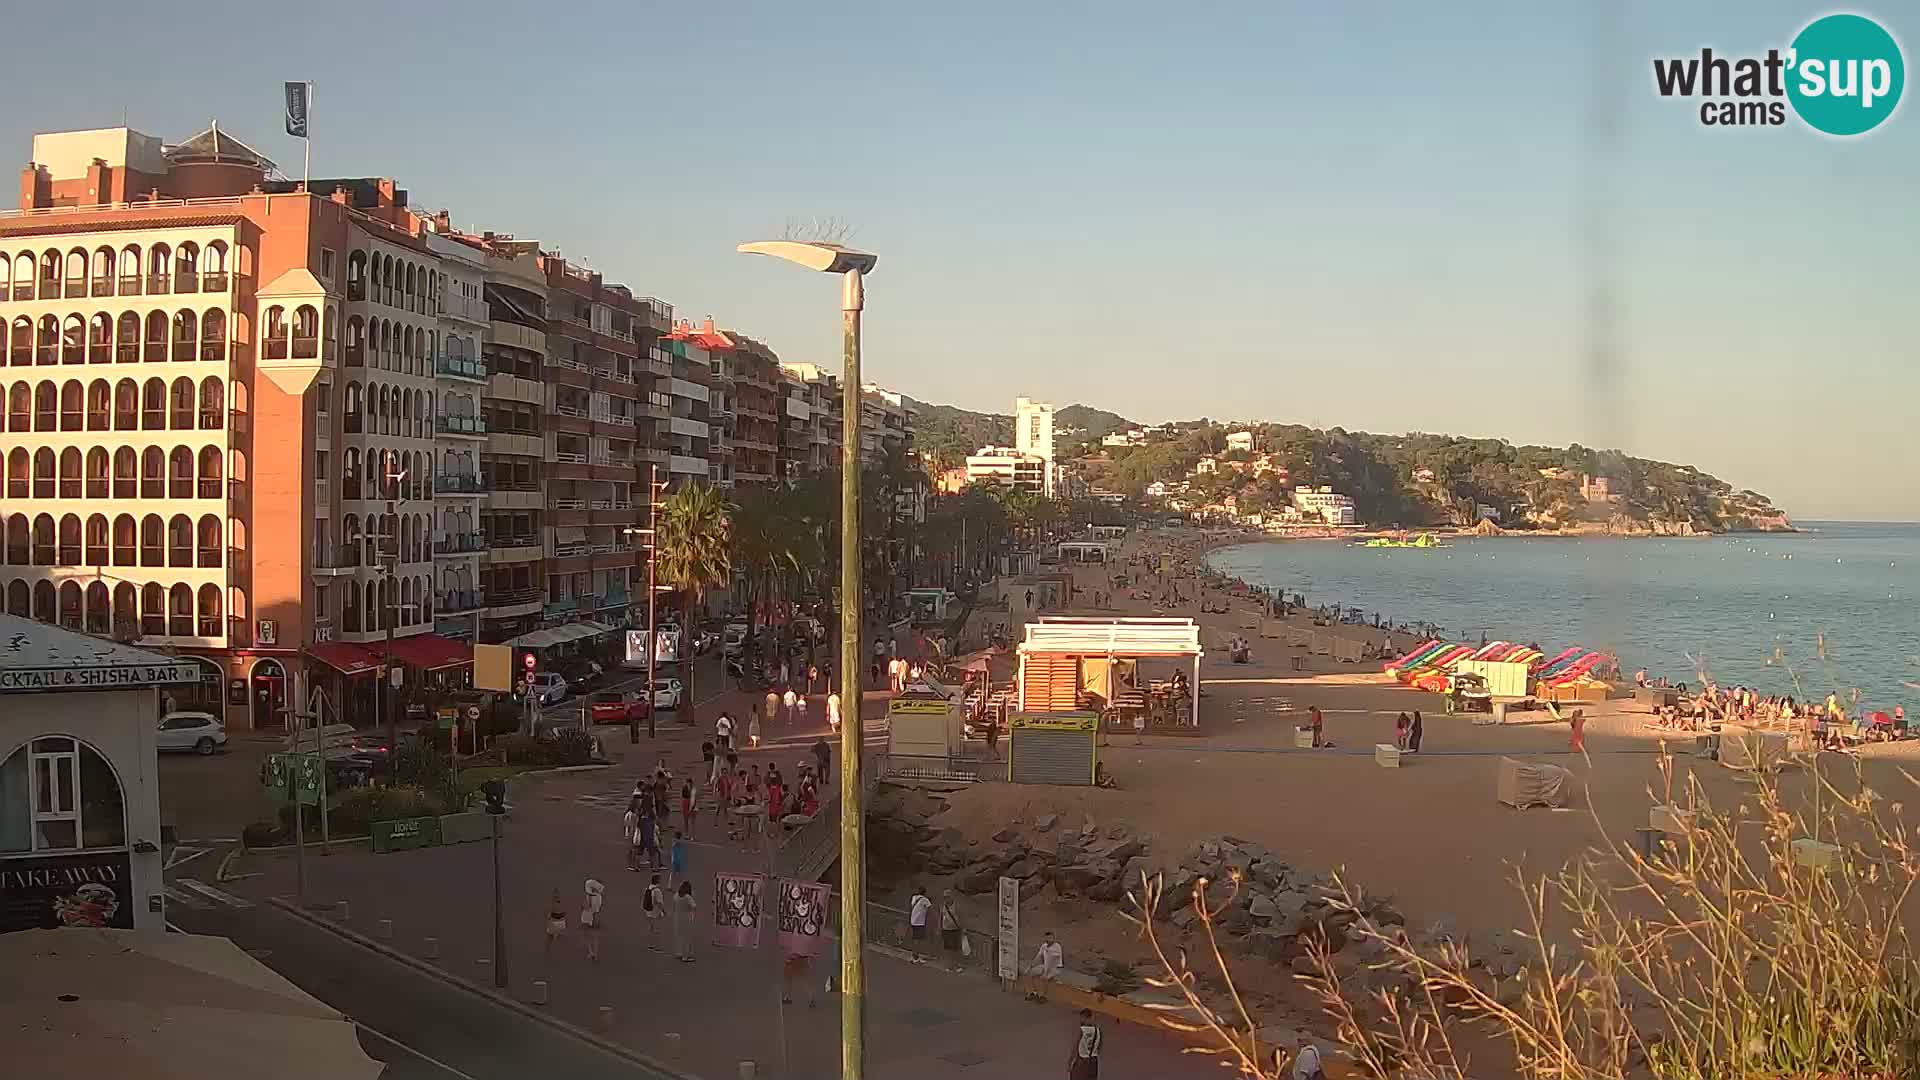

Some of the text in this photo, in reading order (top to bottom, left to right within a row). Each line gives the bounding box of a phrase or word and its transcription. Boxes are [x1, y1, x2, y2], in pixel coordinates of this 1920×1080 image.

[64, 672, 75, 685] &
[79, 668, 142, 685] SHISHA
[147, 667, 179, 682] BAR
